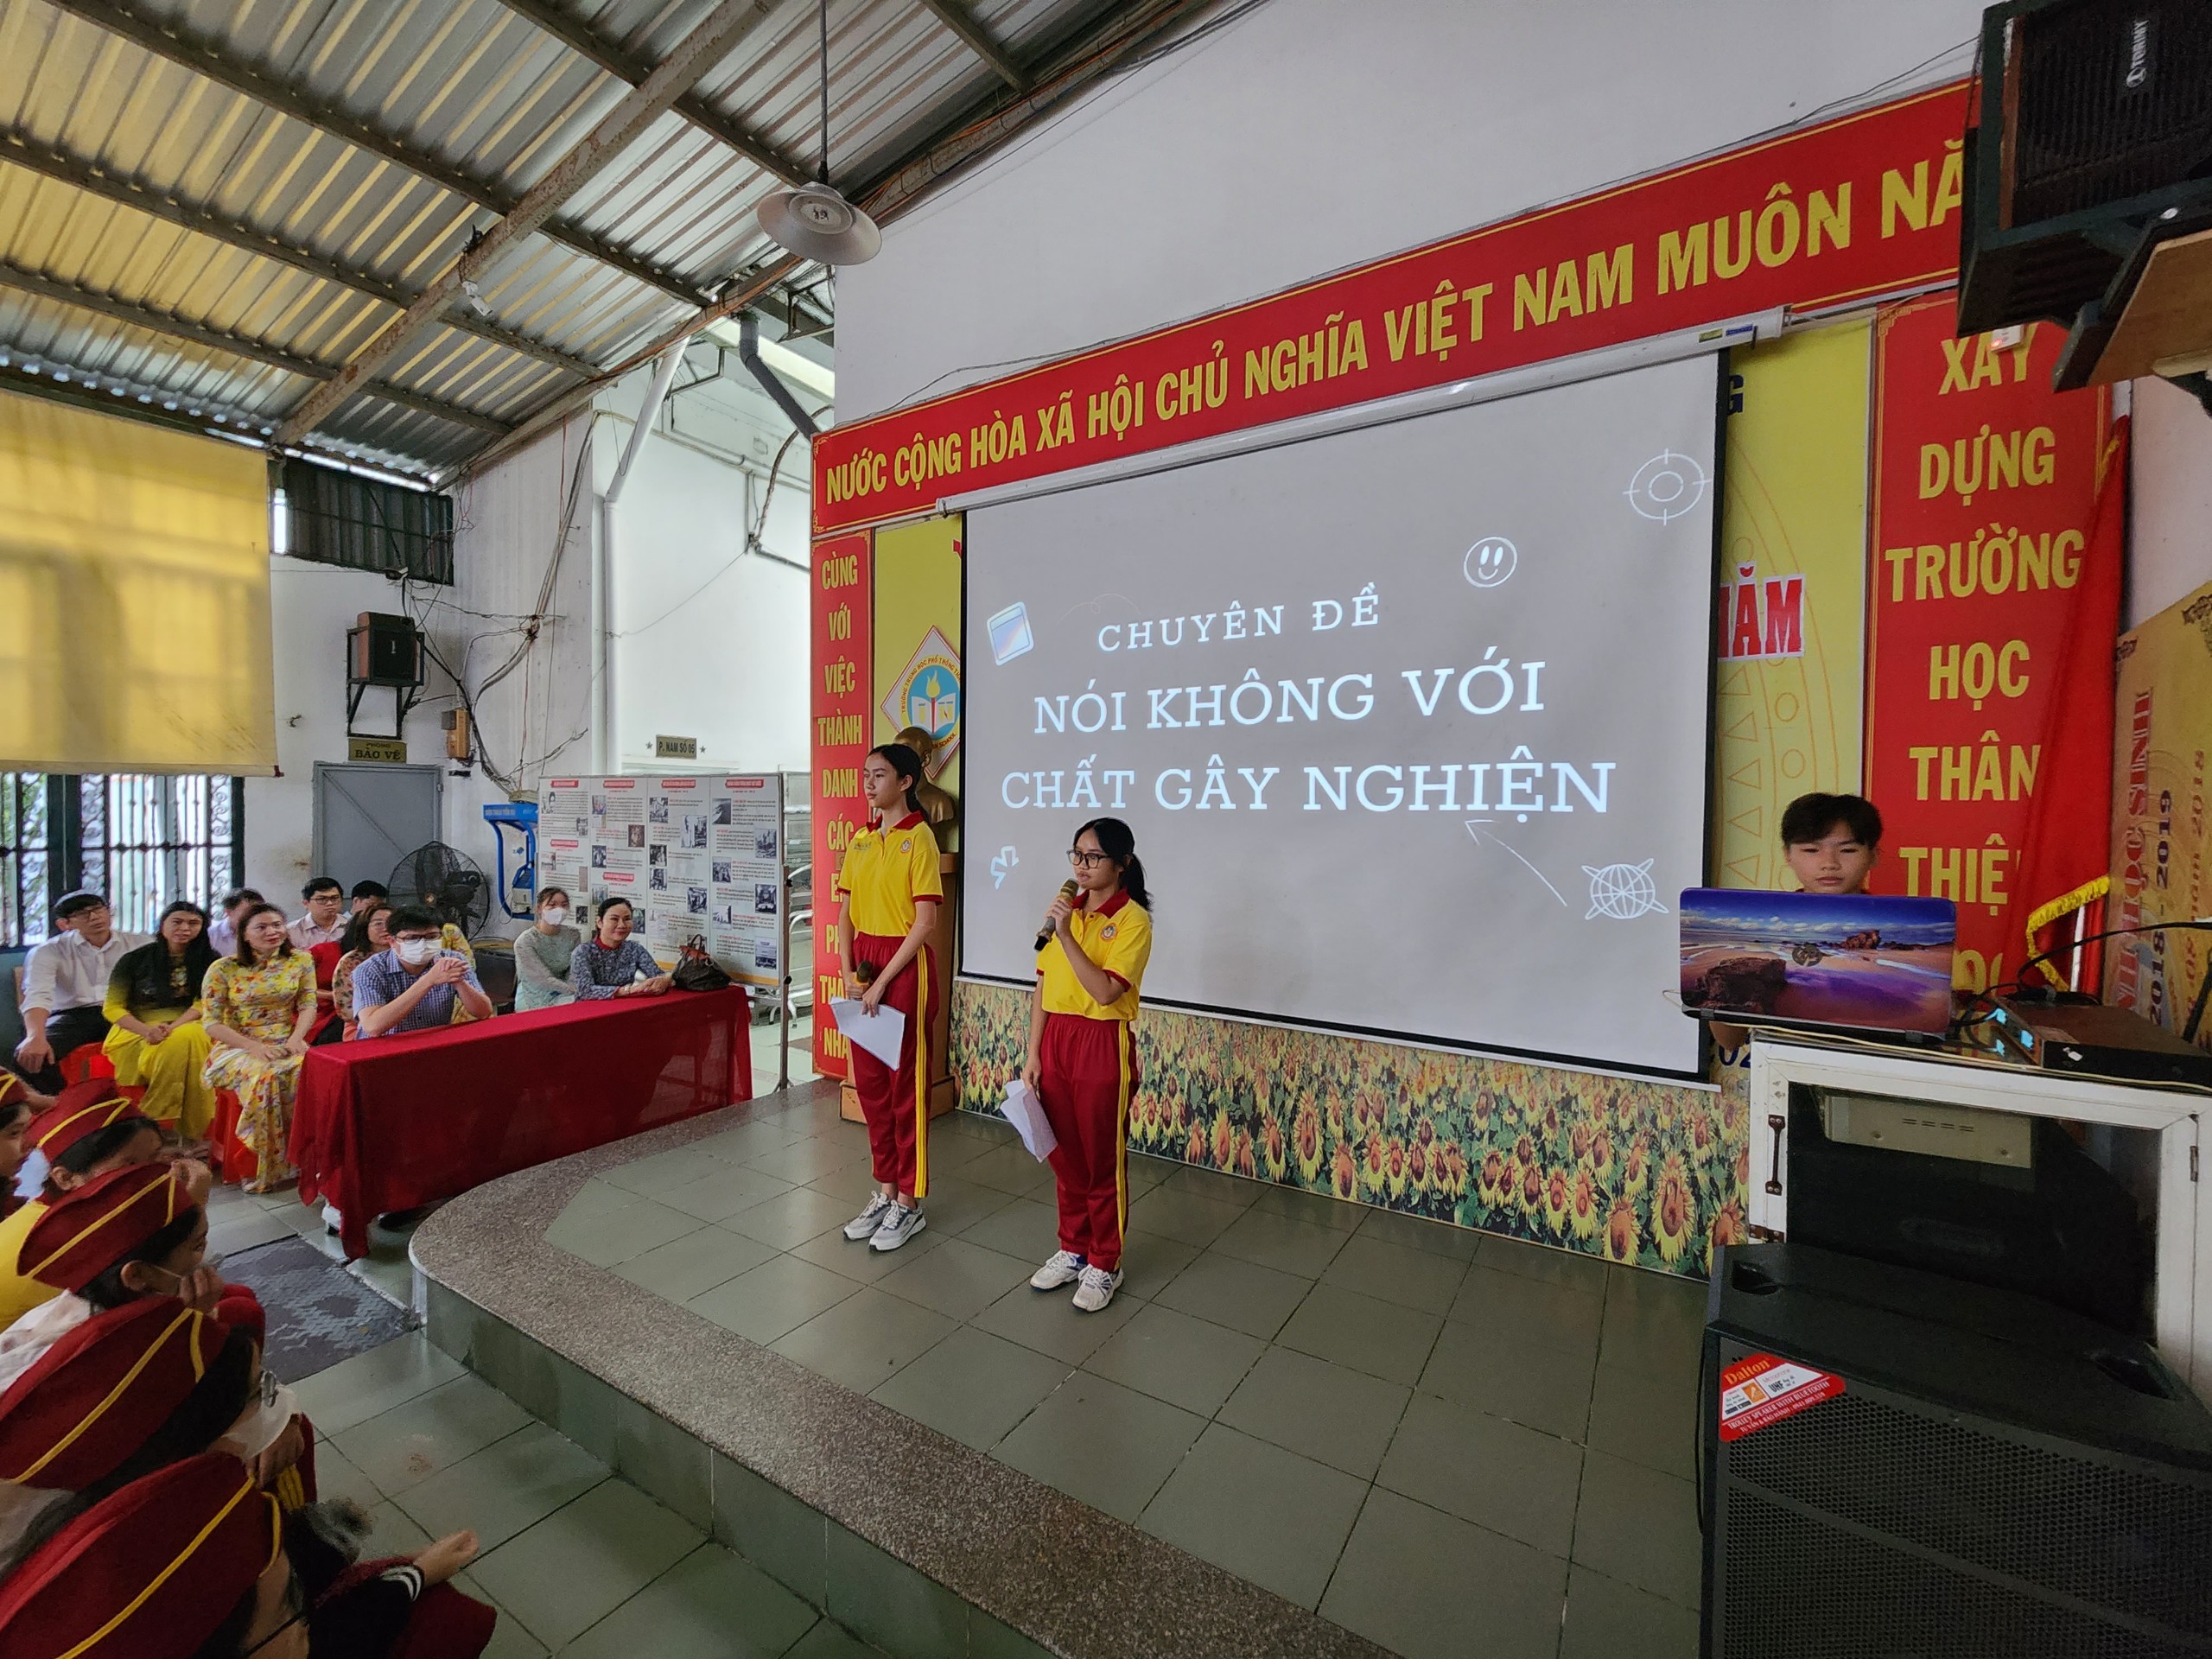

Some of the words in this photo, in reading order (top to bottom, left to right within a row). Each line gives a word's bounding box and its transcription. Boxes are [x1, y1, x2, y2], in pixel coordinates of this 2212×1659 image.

[826, 449, 887, 504] NƯỚC
[893, 434, 962, 491] CỘNG
[970, 410, 1027, 467] HÒA
[1036, 389, 1075, 450] XÃ
[1087, 375, 1144, 441] HỘI
[1156, 341, 1228, 421] CHỦ
[1243, 310, 1369, 399] NGHĨA
[1383, 280, 1493, 363] VIỆT
[1514, 244, 1634, 331] NAM
[1657, 182, 1852, 296] MUÔN
[1881, 137, 1963, 238] NĂ
[1919, 424, 2056, 506] DỰNG
[821, 550, 858, 590] CÙNG
[1885, 522, 2085, 602] TRƯỜNG
[828, 601, 852, 642] VỚI
[1097, 600, 1286, 652] CHUYÊN
[1311, 582, 1380, 632] ĐỀ
[823, 655, 855, 699] VIỆC
[1033, 678, 1128, 734] NÓI
[1146, 666, 1376, 730] KHÔNG
[1400, 645, 1547, 717] VỚI
[1929, 639, 2030, 711] HỌC
[817, 709, 862, 747] THÀNH
[823, 768, 859, 798] DANH
[1001, 753, 1136, 810] CHẤT
[1154, 753, 1281, 811] GÂY
[1302, 744, 1618, 823] NGHIỆN
[1909, 730, 2041, 801] THÂN
[827, 812, 855, 850] CÁC
[2156, 790, 2171, 890] 2019
[1899, 833, 2022, 917] THIỆ
[819, 969, 844, 1005] THÀ
[1725, 1359, 1770, 1385] Dalton
